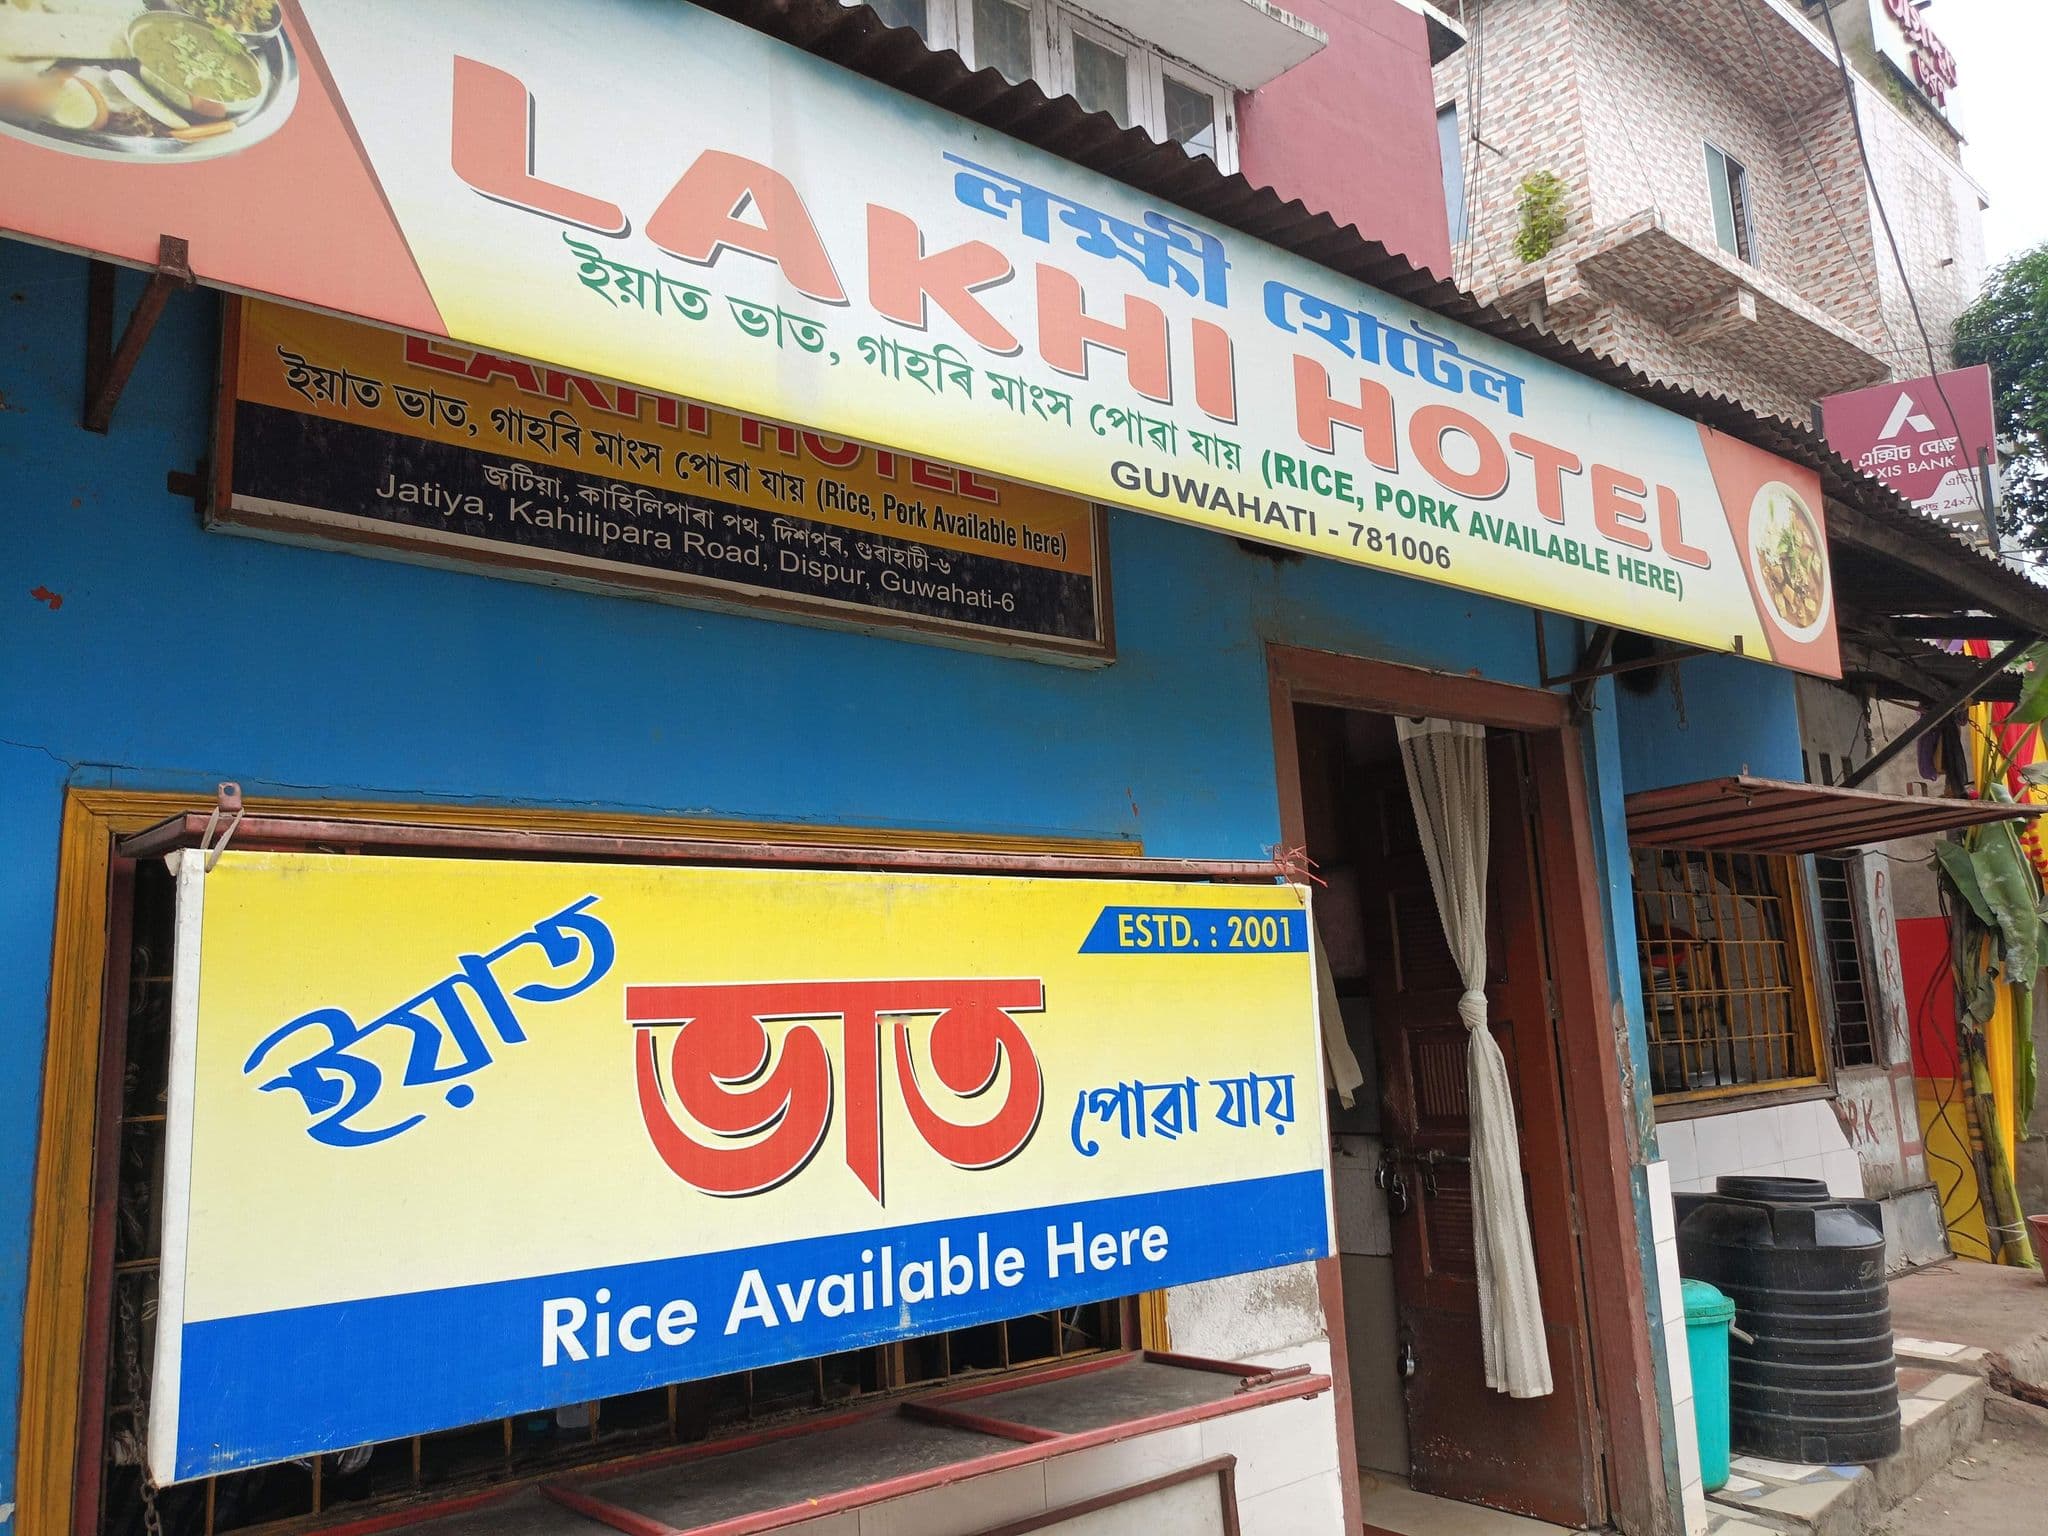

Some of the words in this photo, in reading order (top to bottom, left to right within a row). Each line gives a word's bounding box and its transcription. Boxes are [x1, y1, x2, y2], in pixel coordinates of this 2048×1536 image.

[451, 54, 1239, 426] LAKHI
[1293, 353, 1711, 570] HOTEL
[1263, 280, 1525, 417] হোটেল
[277, 345, 384, 407] ইয়াত
[393, 384, 478, 437] ভাত,
[490, 406, 582, 456] গাহৰি
[591, 428, 662, 474] মাংস
[675, 451, 750, 494] পোৱা
[759, 467, 805, 504] যায়
[817, 478, 876, 521] (Rice,
[884, 493, 927, 529] Pork
[933, 505, 1017, 547] Available
[1022, 523, 1067, 562] here)
[563, 231, 713, 320] ইয়াত
[725, 295, 840, 366] ভাত,
[857, 334, 974, 400] গাহৰি
[985, 370, 1073, 427] মাংস
[1089, 403, 1178, 457] পোৱা
[1187, 429, 1241, 474] যায়
[1261, 449, 1365, 512] (RICE,
[1376, 486, 1460, 533] PORK
[1469, 511, 1610, 575] AVAILABLE
[1618, 553, 1684, 602] HERE)
[1907, 455, 1957, 474] BANK
[376, 474, 494, 521] Jatiya,
[510, 497, 671, 550] Kahilipara
[683, 532, 768, 572] Road,
[780, 549, 871, 590] Dispur,
[880, 571, 1016, 613] Guwahati-6
[482, 463, 570, 503] জটিয়া,
[577, 482, 714, 529] কাহিলিপাৰা
[722, 513, 766, 541] পথ,
[772, 517, 849, 558] দিশপুৰ,
[856, 540, 952, 574] গুৱাহাটী-৬
[1110, 461, 1316, 536] GUWAHATI
[1347, 521, 1452, 570] 781006
[1117, 913, 1199, 948] ESTD.
[1228, 914, 1293, 948] 2001
[1874, 870, 1909, 1048] PORK
[243, 893, 616, 1148] ইয়াত
[625, 977, 1046, 1209] ভাত
[1070, 1076, 1199, 1157] পোৱা
[1209, 1071, 1296, 1137] যায়
[541, 1288, 699, 1368] Rice
[723, 1232, 1026, 1336] Available
[1047, 1220, 1170, 1279] Here
